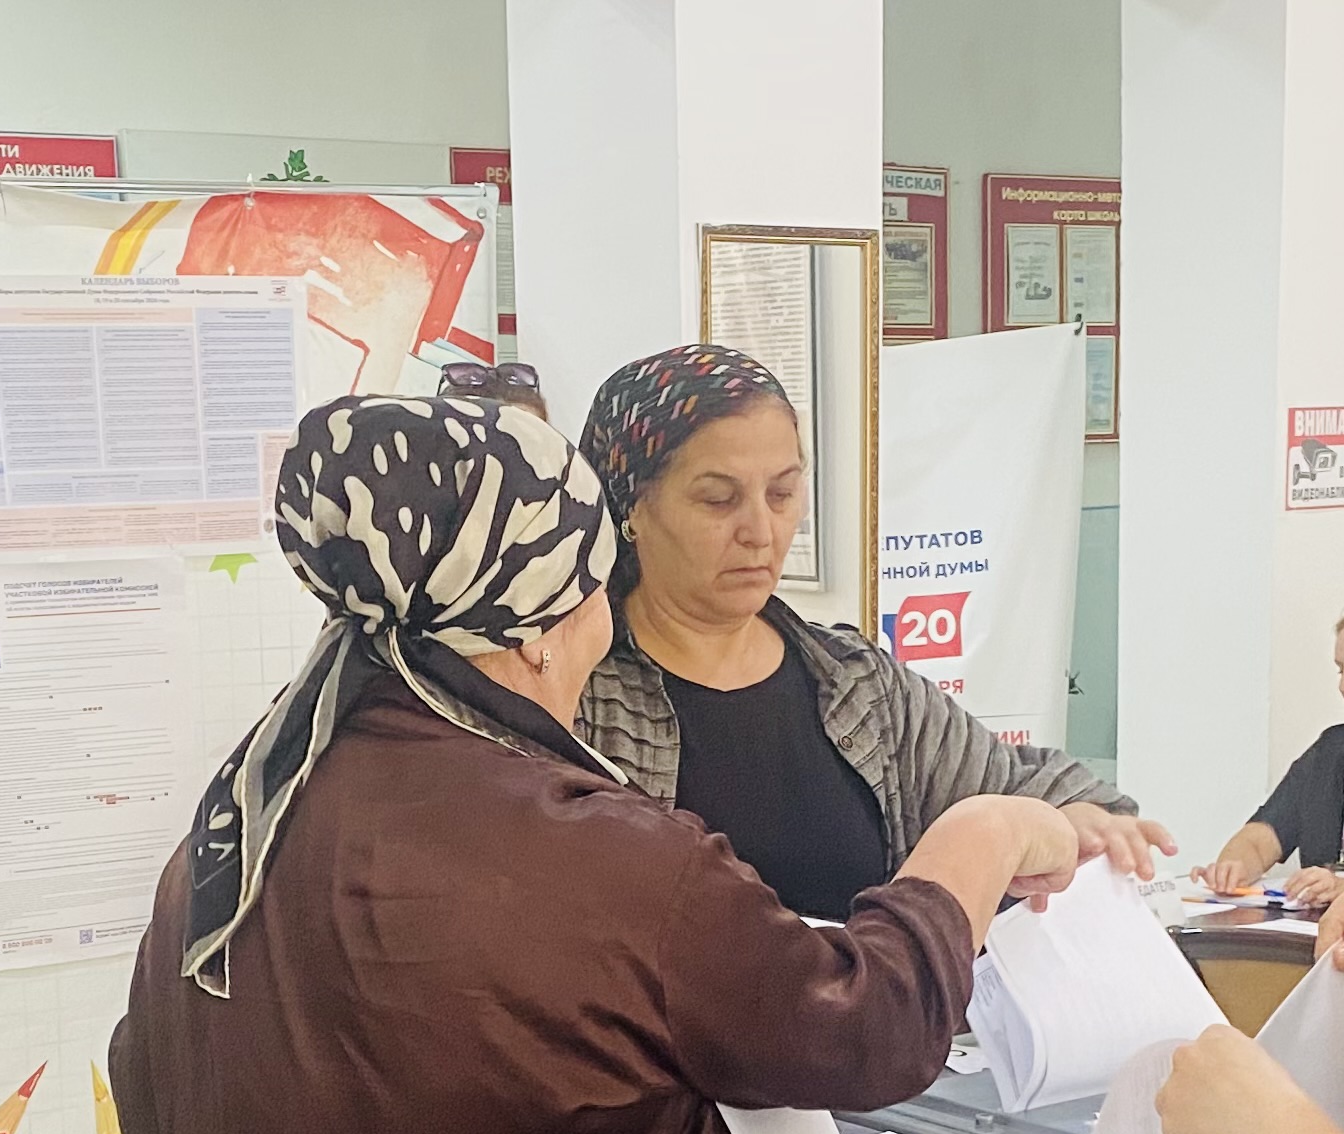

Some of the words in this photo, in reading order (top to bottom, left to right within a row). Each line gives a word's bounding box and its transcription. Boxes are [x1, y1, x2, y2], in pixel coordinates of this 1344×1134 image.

[1, 162, 95, 178] ДВИЖЕНИЯ
[882, 529, 983, 551] ПУТАТОВ
[935, 558, 989, 579] ДУМЫ
[900, 608, 956, 647] 20
